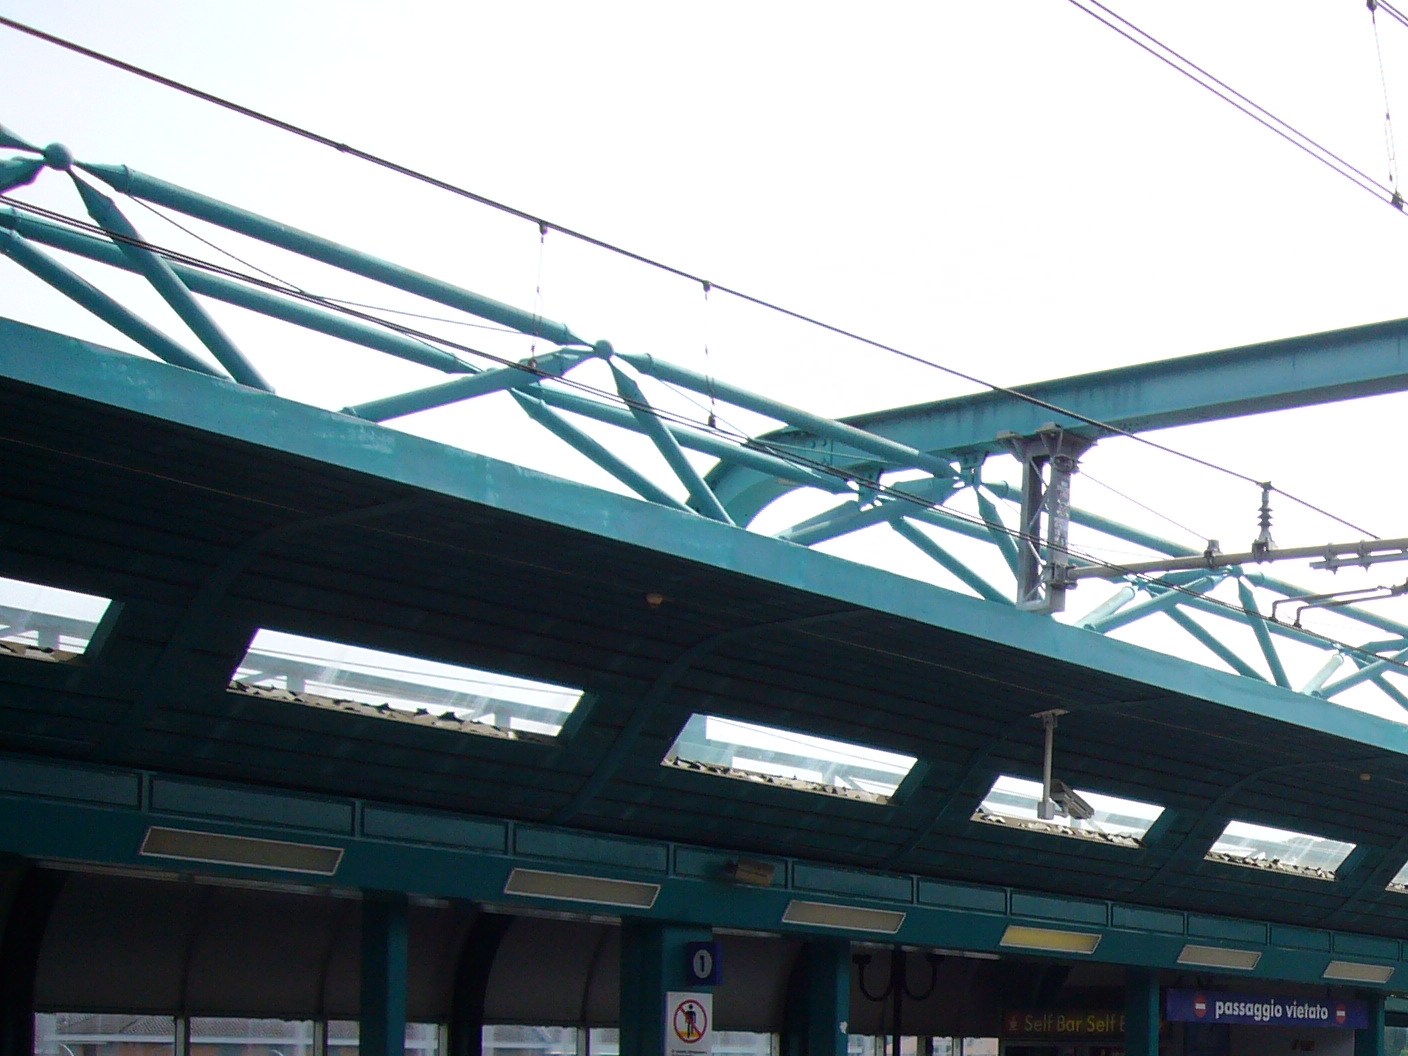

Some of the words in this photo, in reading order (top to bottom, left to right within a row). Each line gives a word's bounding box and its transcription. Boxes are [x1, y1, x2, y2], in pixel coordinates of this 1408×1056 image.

[1214, 999, 1283, 1022] passaggio
[1285, 1001, 1329, 1019] vietato
[1024, 1014, 1054, 1032] Self
[1056, 1015, 1083, 1032] Bar
[1087, 1014, 1117, 1032] Self
